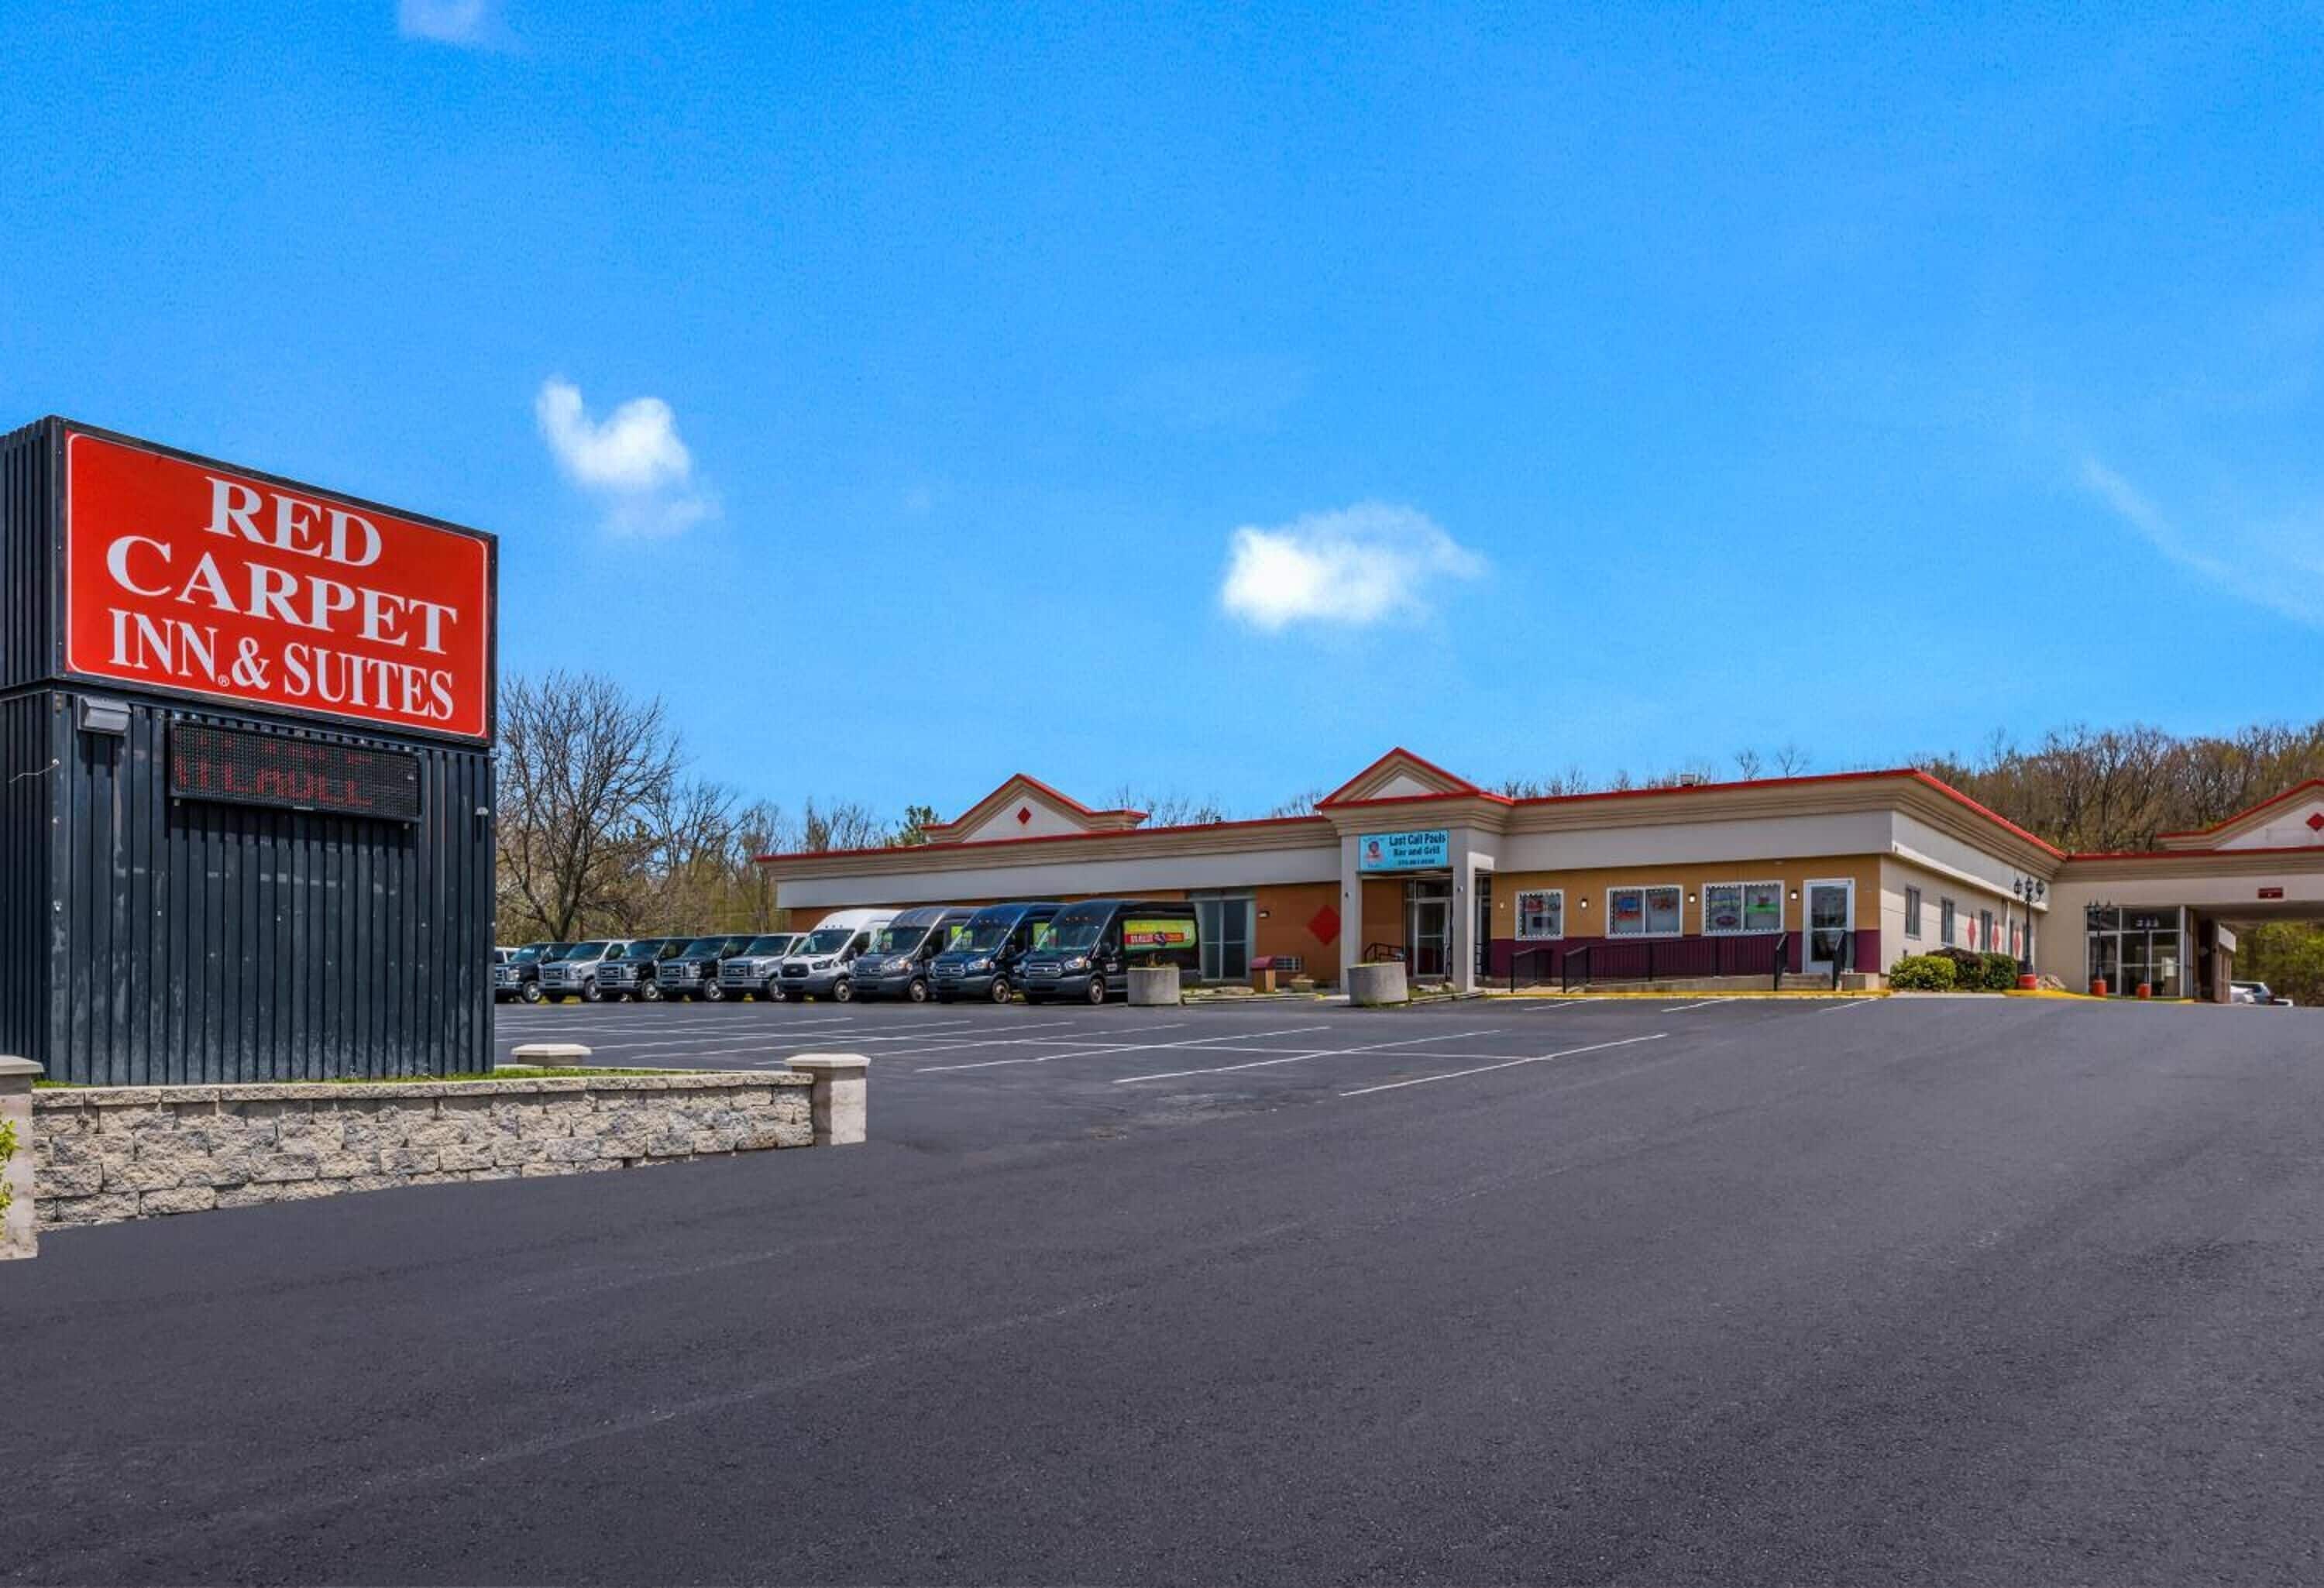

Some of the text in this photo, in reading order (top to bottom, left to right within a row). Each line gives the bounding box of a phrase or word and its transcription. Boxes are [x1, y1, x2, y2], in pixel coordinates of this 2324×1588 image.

[205, 476, 383, 567] RED
[106, 534, 458, 655] CARPET
[232, 635, 270, 690] &
[284, 641, 454, 721] SUITES
[1389, 835, 1406, 847] Last
[1408, 834, 1423, 845] Call
[1394, 846, 1439, 857] Bar and Grill
